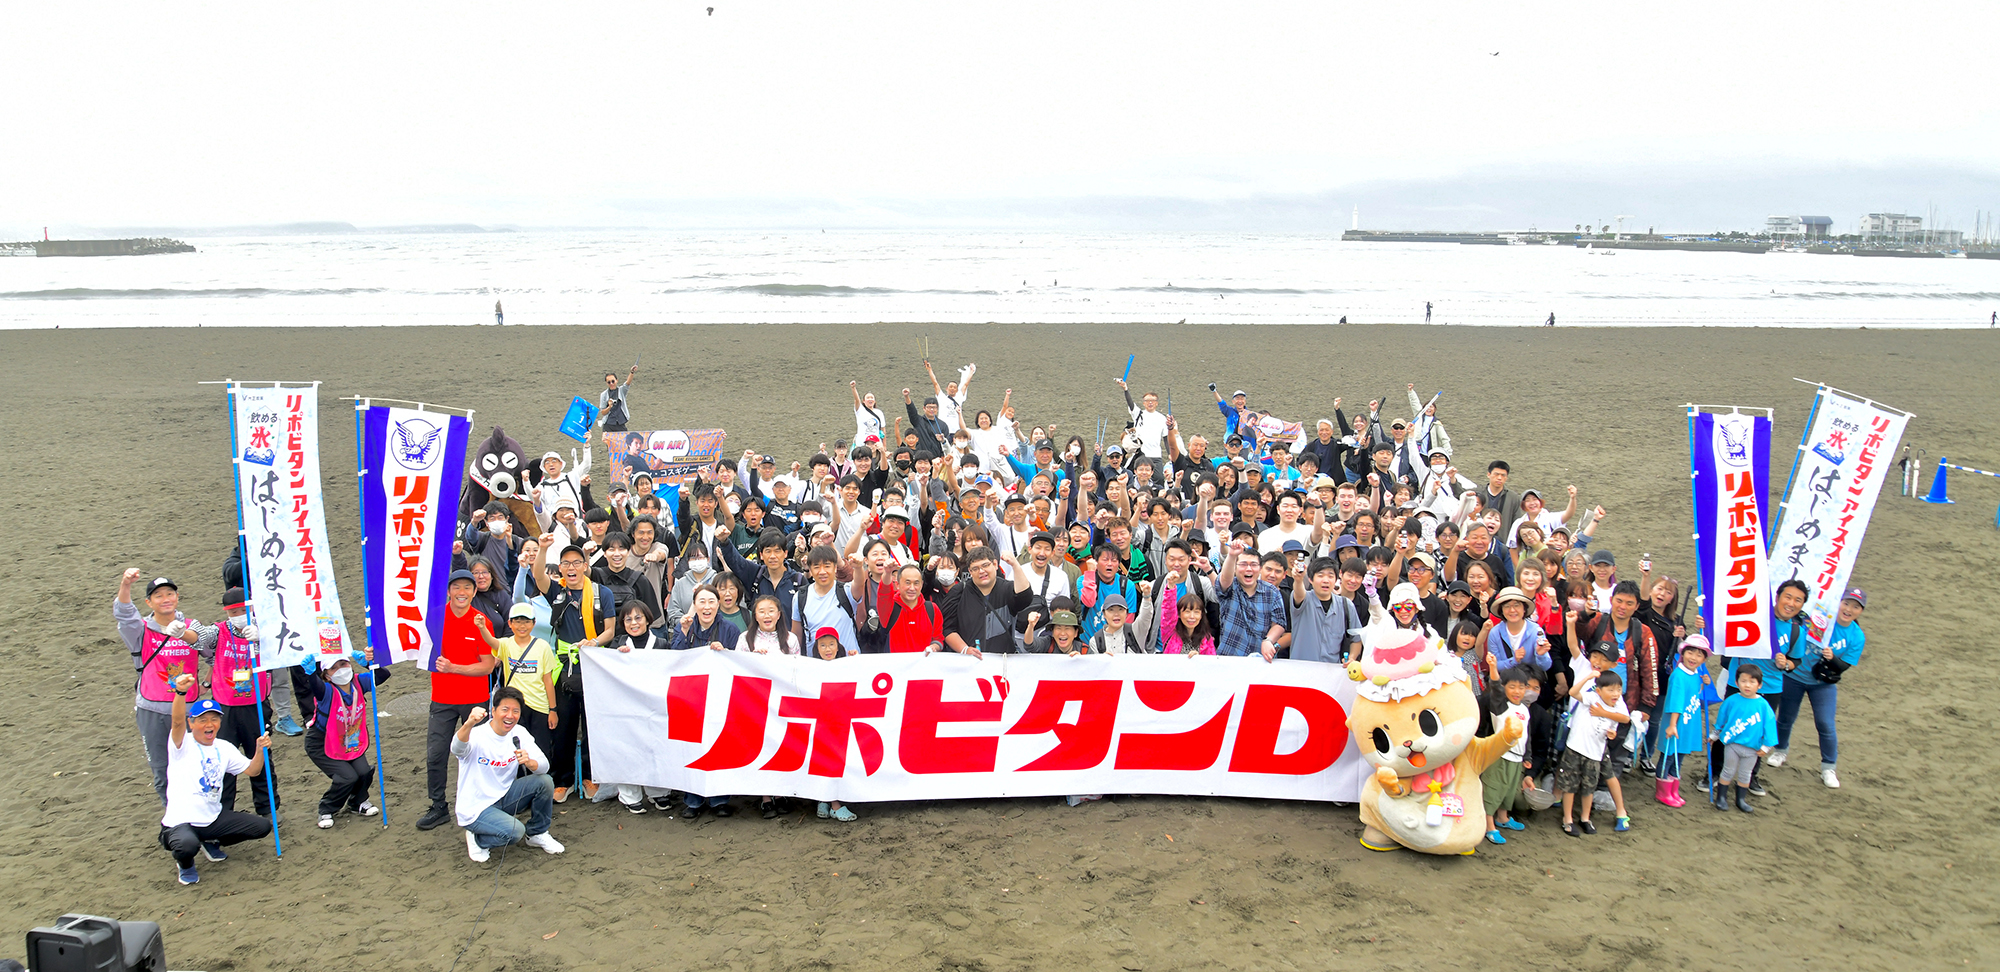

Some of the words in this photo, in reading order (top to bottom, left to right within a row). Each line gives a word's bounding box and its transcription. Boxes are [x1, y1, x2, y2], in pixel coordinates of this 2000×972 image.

[250, 412, 278, 424] 飲める
[250, 426, 271, 449] 氷
[286, 394, 305, 489] リポビタン
[653, 441, 665, 450] ON
[1825, 429, 1848, 451] 氷
[1832, 417, 1860, 433] 飲める
[1847, 415, 1891, 497] リポビタン
[251, 470, 304, 655] はじめました
[292, 494, 322, 612] アイススラリー
[1725, 471, 1760, 648] リポビタンD
[1817, 498, 1860, 600] アイススラリー
[666, 672, 1350, 778] リポビタンD
